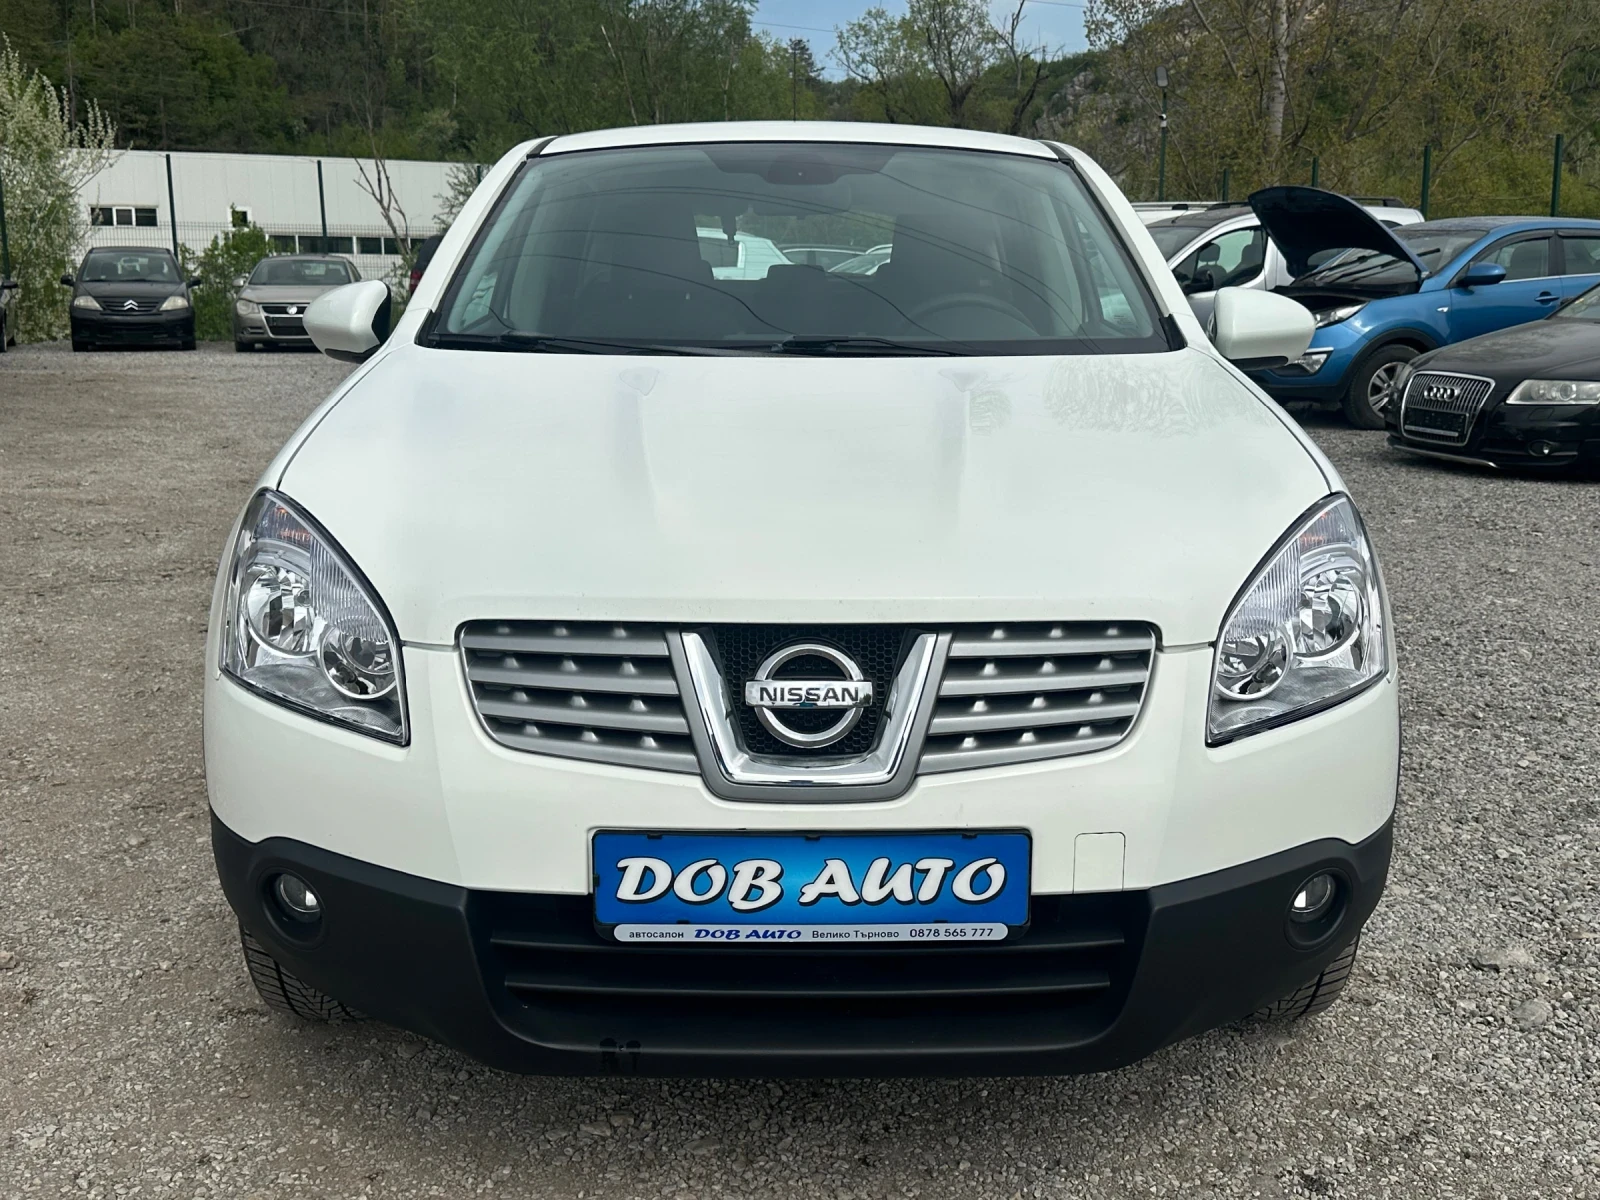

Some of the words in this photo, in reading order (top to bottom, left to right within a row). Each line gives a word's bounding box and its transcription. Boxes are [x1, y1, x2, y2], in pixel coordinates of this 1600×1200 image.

[759, 687, 859, 702] NISSAN
[615, 857, 784, 912] DOB
[798, 857, 1007, 905] AUTO
[628, 931, 684, 939] автосалон
[694, 928, 741, 940] DOB
[745, 928, 802, 939] AUTO
[812, 930, 850, 939] Велико
[853, 929, 900, 940] Търново
[909, 928, 940, 938] 0878
[944, 928, 967, 937] 565
[971, 928, 994, 937] 777
